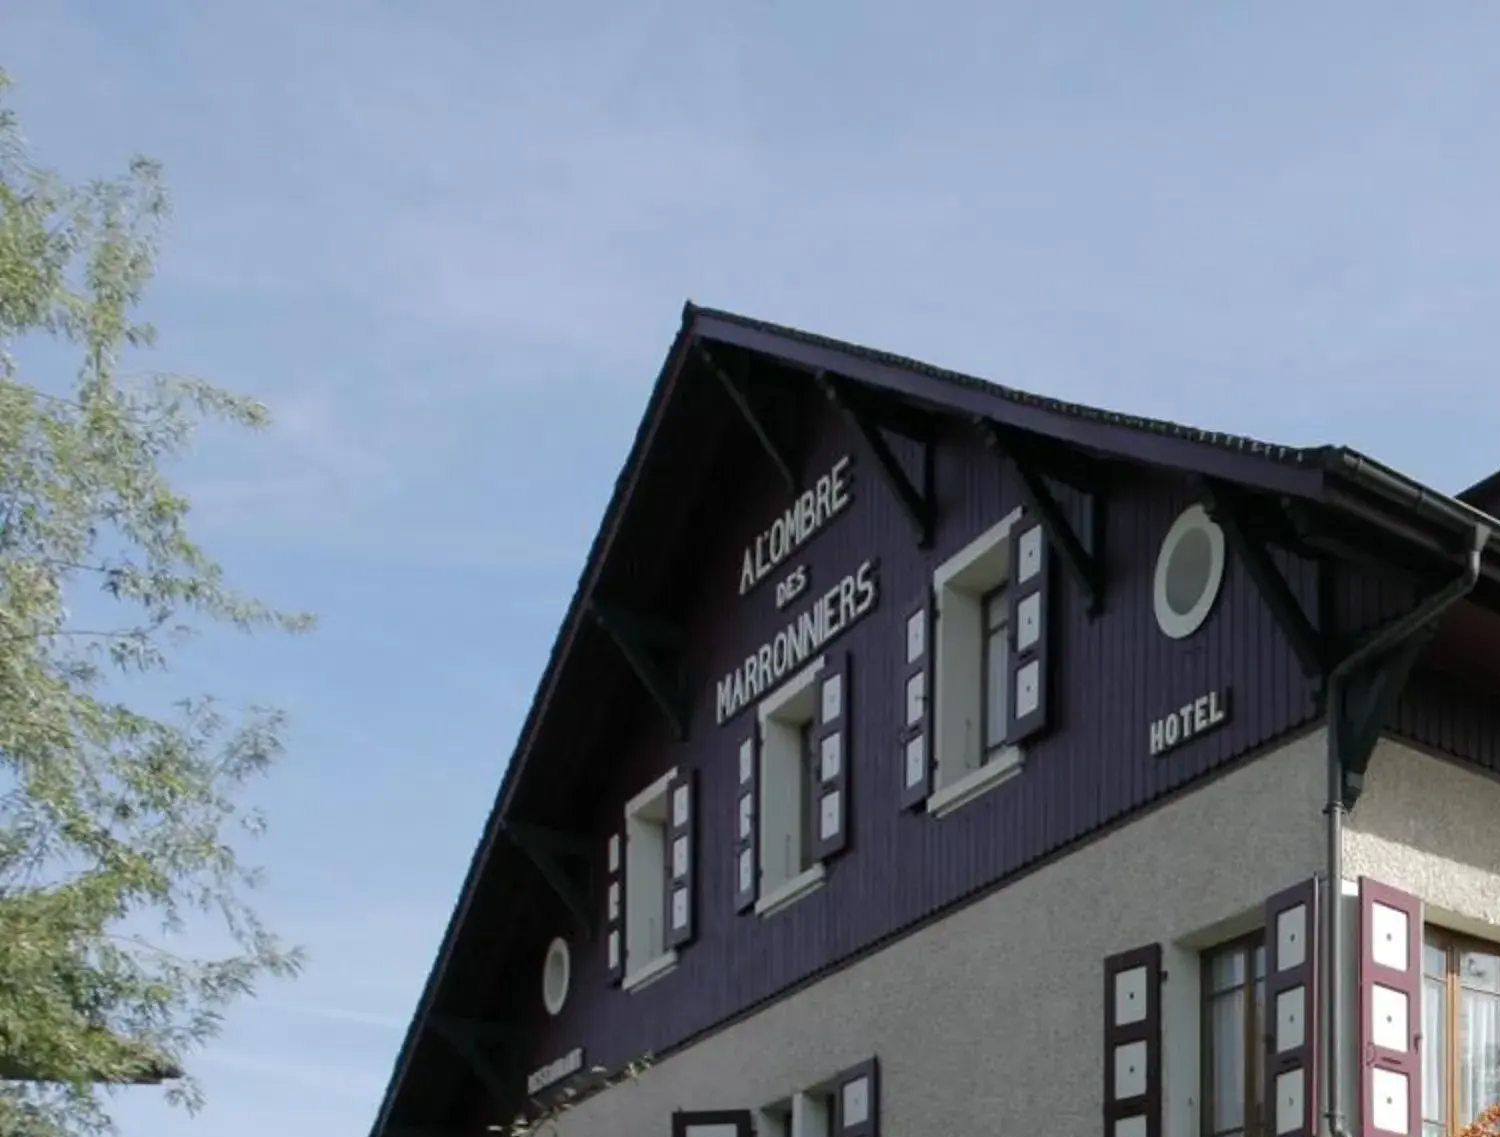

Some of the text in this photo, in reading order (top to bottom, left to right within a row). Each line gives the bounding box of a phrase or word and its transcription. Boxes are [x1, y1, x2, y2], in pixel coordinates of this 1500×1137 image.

[776, 564, 806, 609] DES
[716, 558, 874, 725] MARRONNIERS
[1149, 691, 1224, 755] HOTEL
